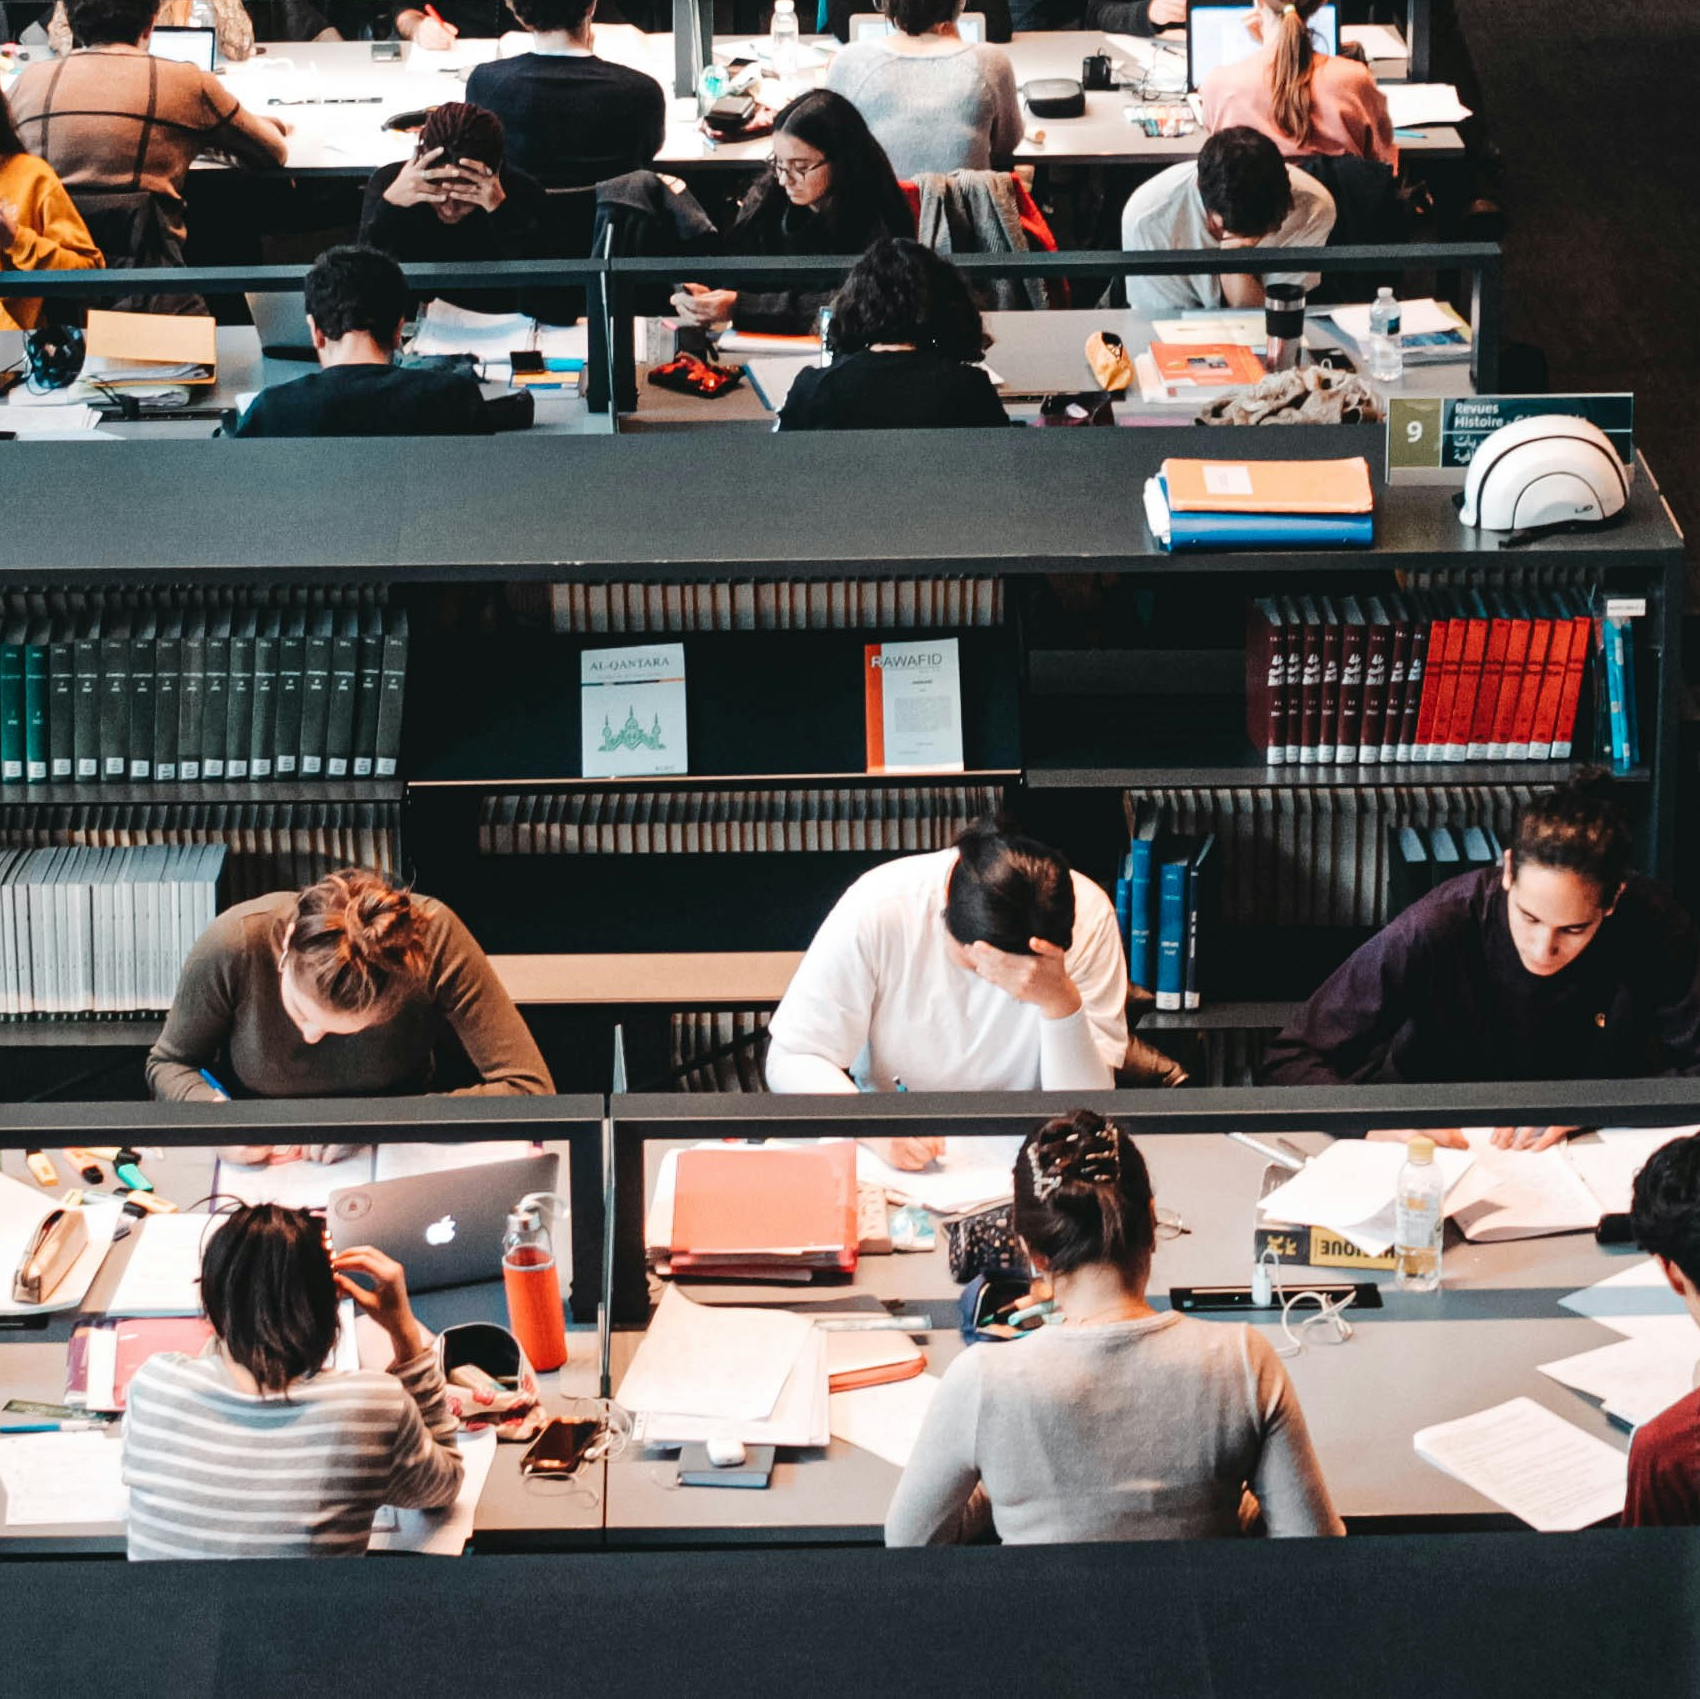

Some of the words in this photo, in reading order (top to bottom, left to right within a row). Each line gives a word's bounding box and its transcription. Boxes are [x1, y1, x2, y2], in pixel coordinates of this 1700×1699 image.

[1455, 402, 1499, 414] Revues
[1454, 415, 1503, 428] Histoire
[1407, 421, 1423, 443] 9
[590, 657, 670, 671] AL-QANTARA
[871, 653, 942, 669] RAWAFID
